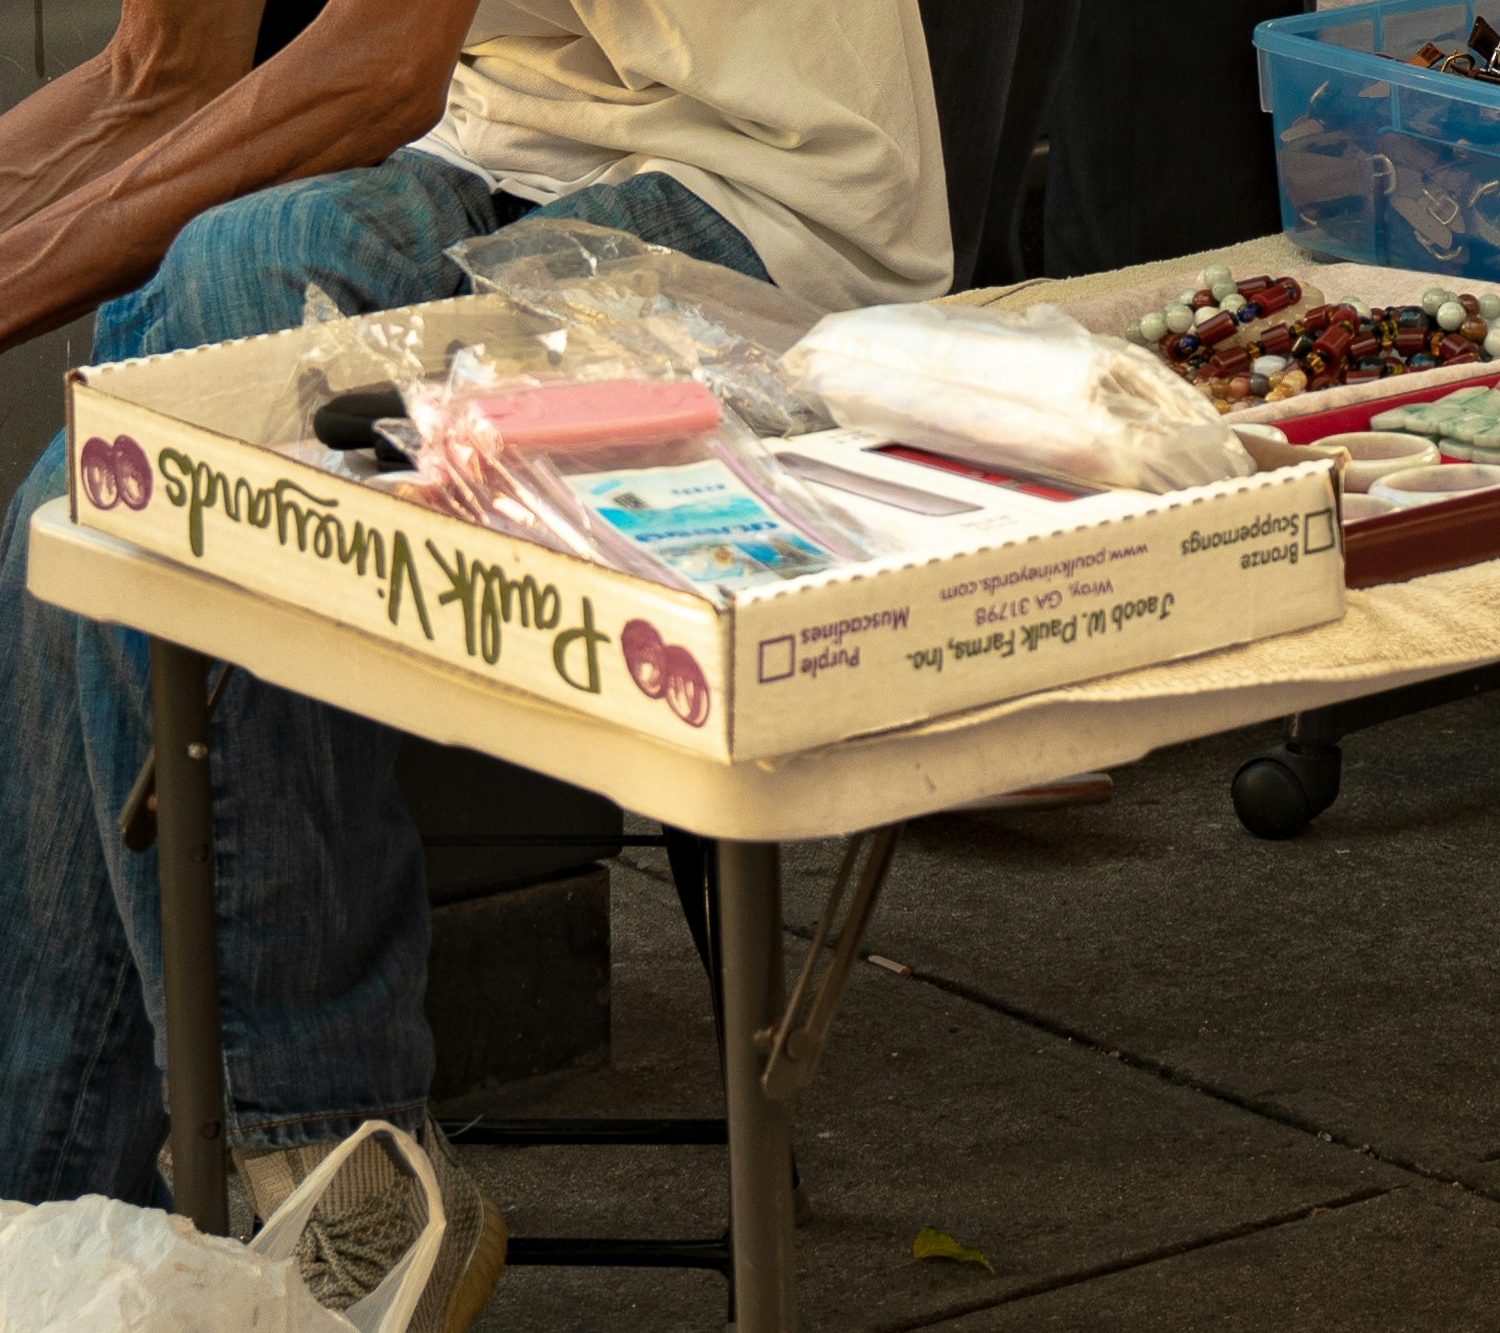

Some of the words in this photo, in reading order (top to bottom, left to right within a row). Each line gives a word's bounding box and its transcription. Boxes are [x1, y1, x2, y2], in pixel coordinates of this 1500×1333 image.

[158, 448, 434, 642] Vineyards
[1180, 513, 1301, 559] Scuppernongs
[939, 541, 1150, 604] www.paulkvineyards.com
[1239, 541, 1301, 574] Bronze
[1033, 591, 1063, 613] GA
[1068, 576, 1114, 601] Wray,
[425, 538, 612, 696] Paulk
[801, 606, 911, 645] Muscadines
[974, 597, 1030, 626] 31798
[1081, 607, 1107, 638] W.
[1110, 591, 1174, 630] Jacob
[947, 626, 1016, 663] Farms,
[1020, 613, 1079, 652] Paulk
[800, 643, 861, 679] Purple
[906, 648, 944, 675] Inc.
